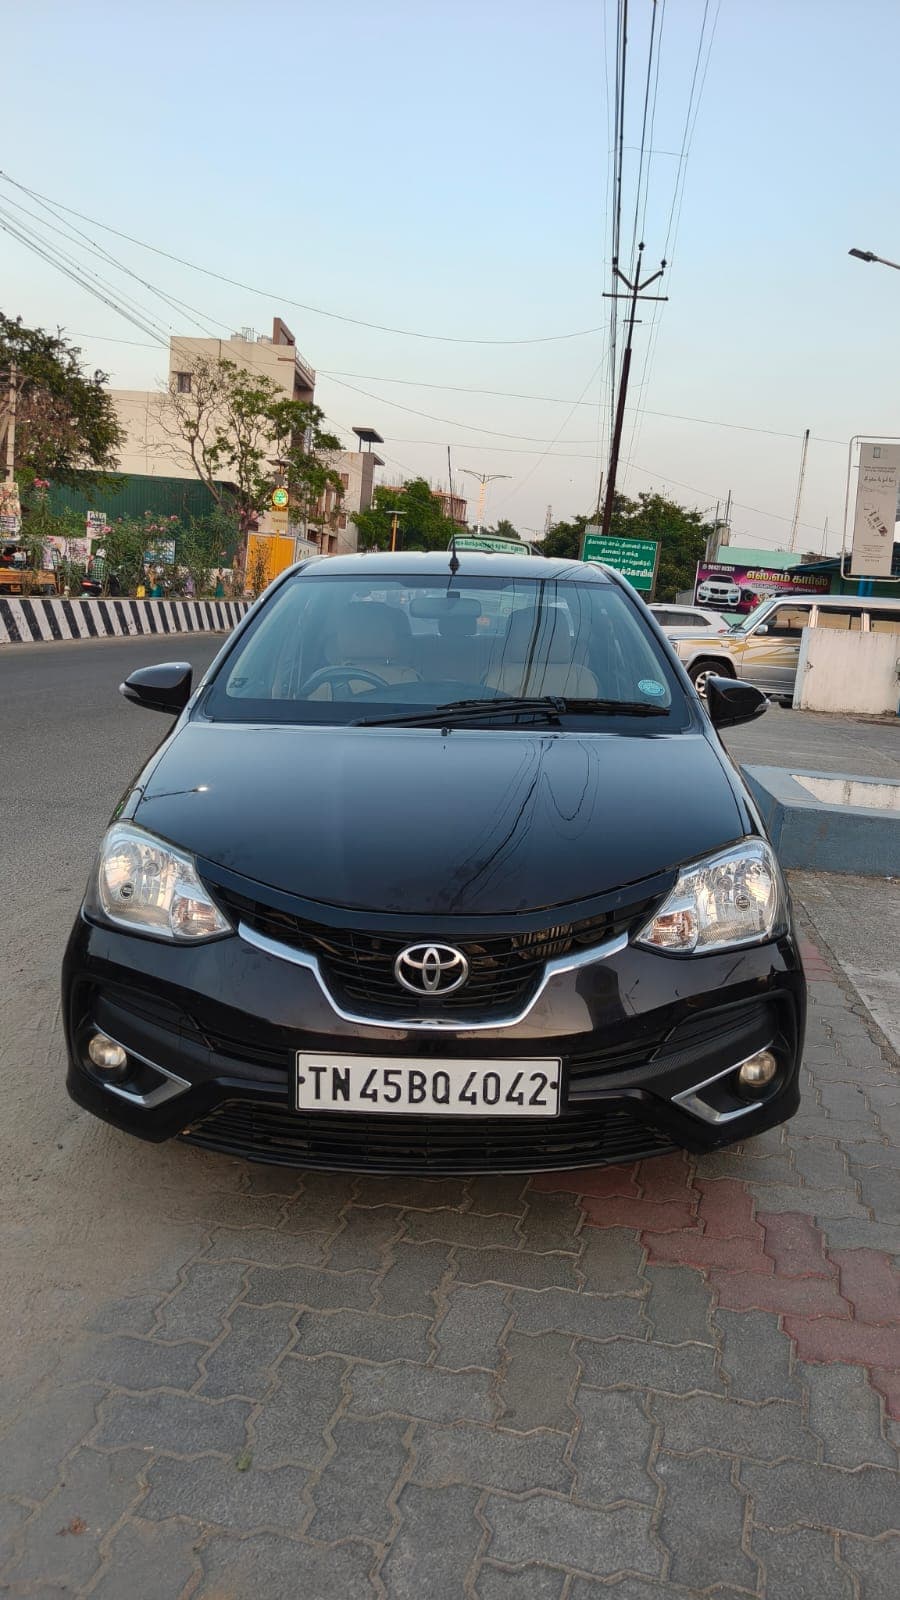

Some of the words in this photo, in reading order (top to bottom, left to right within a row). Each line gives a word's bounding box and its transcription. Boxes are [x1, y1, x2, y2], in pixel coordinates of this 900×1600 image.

[308, 1066, 351, 1102] TN
[359, 1068, 451, 1104] 45BQ
[458, 1071, 548, 1106] 4042
